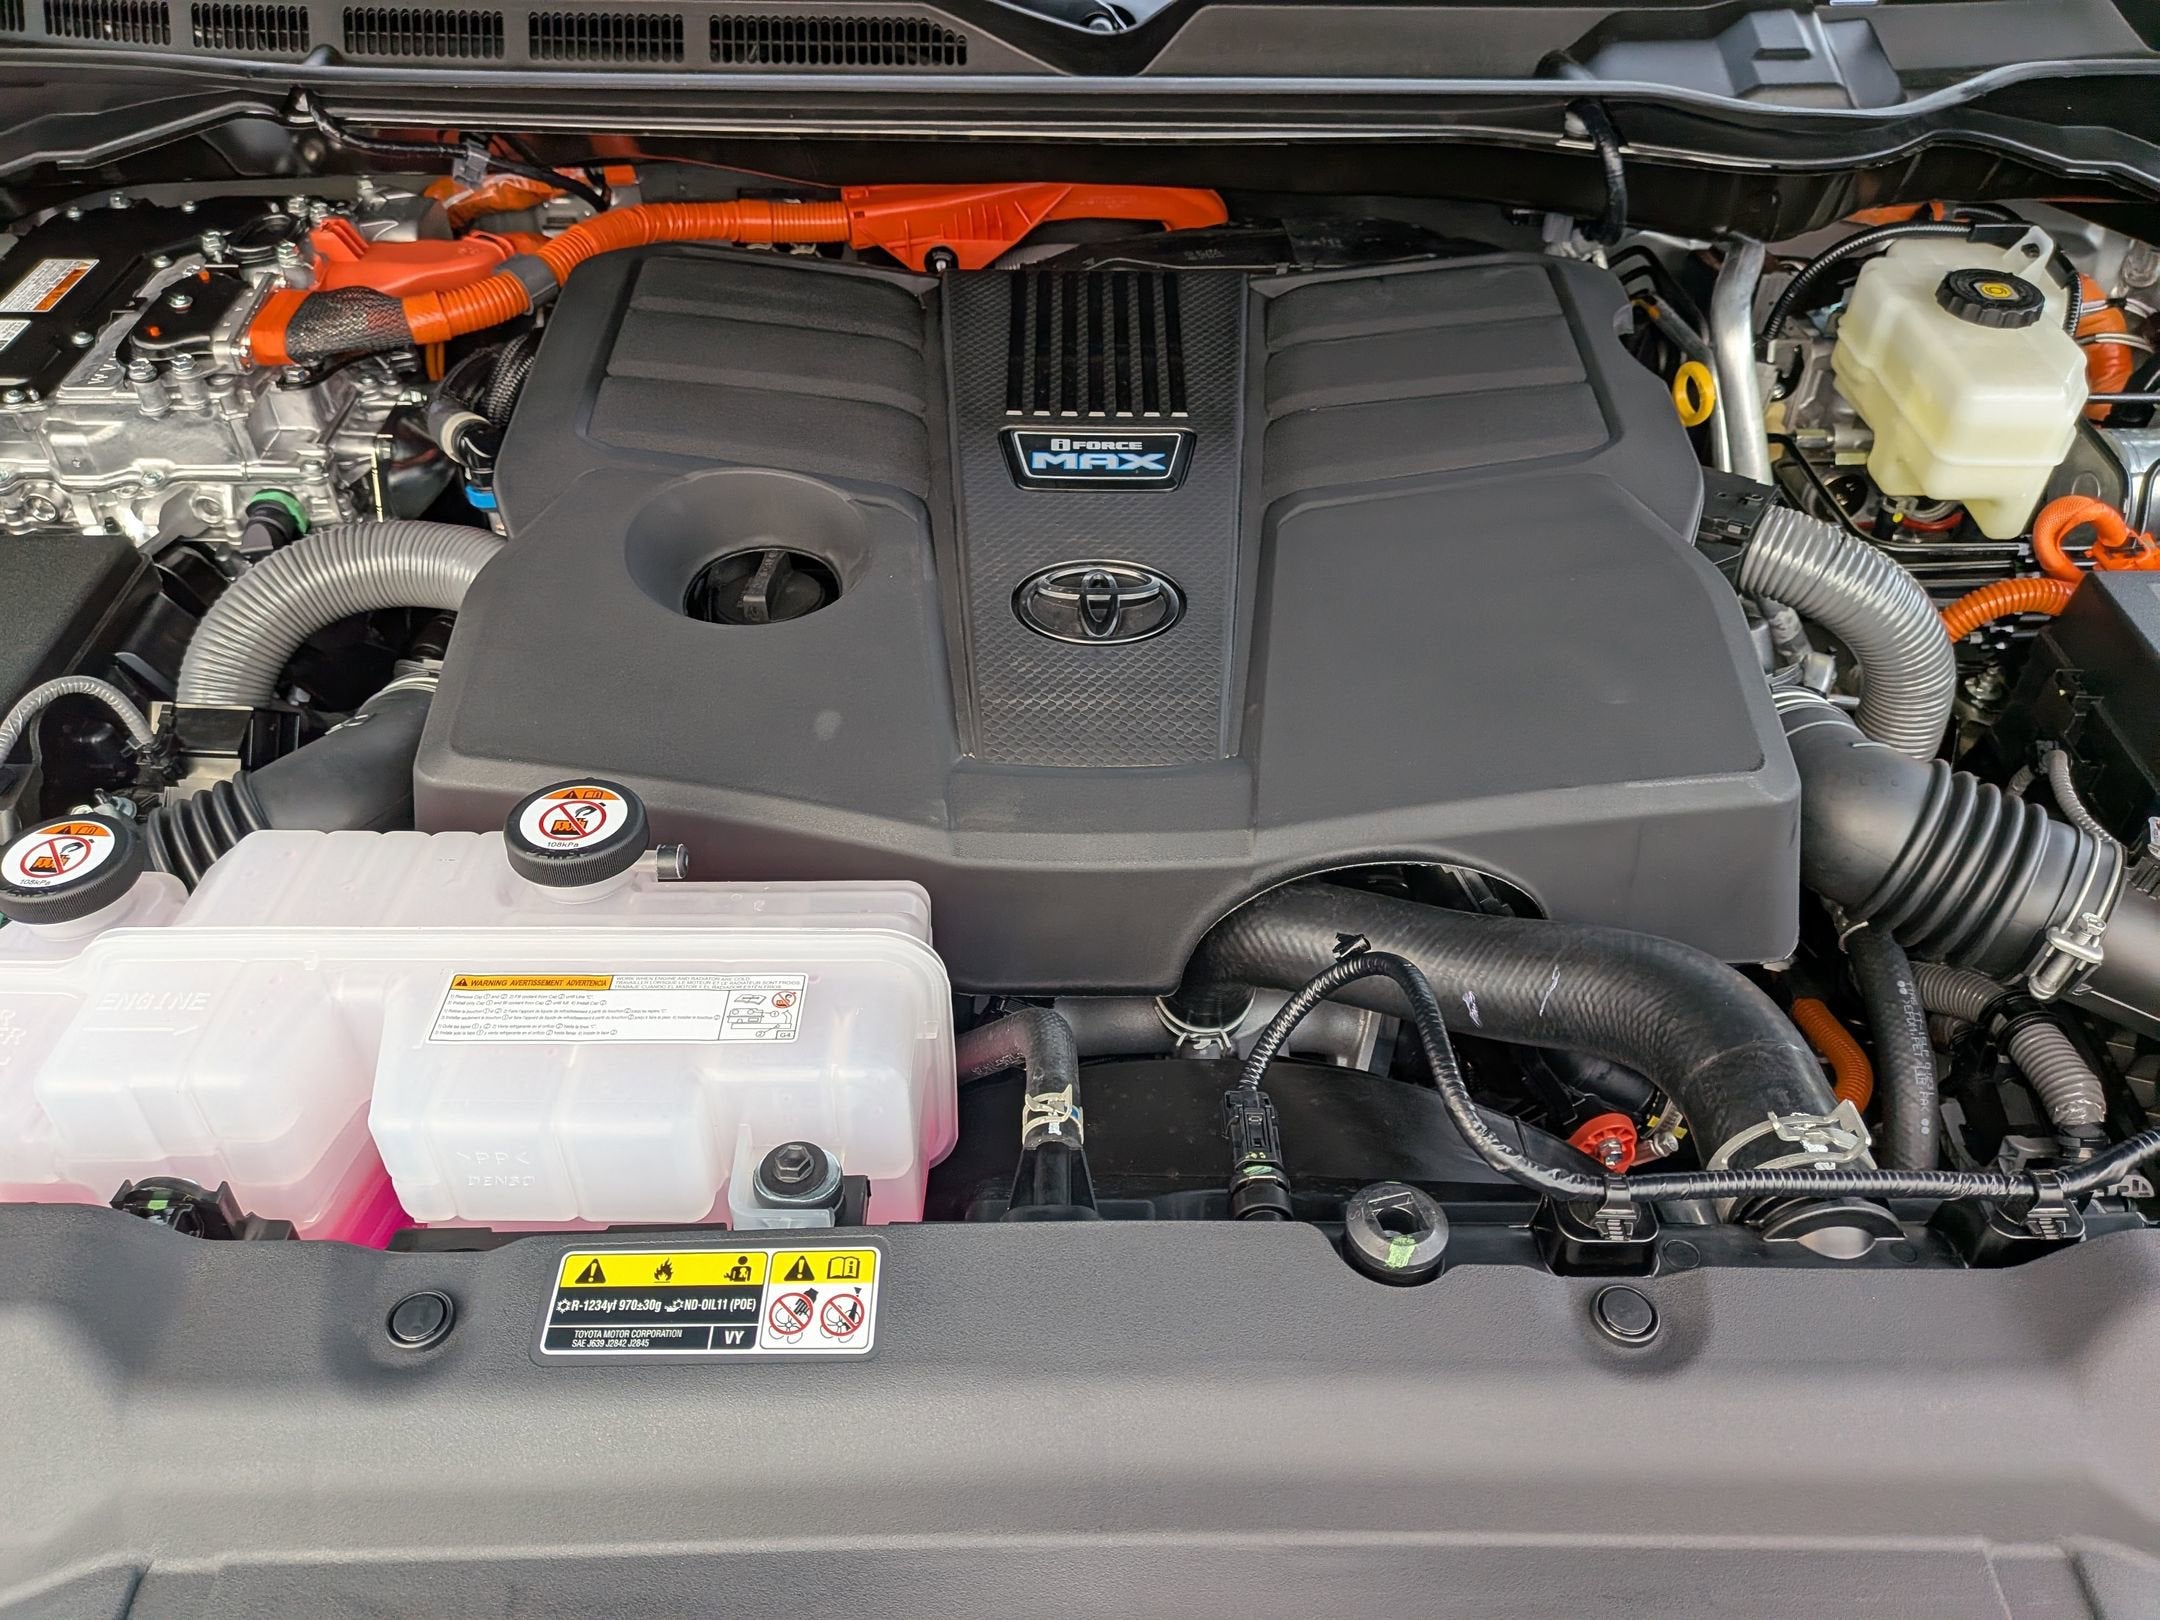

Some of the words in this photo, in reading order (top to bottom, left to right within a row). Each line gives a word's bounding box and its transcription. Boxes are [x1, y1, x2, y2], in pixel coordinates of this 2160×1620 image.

[1032, 452, 1166, 470] MAX
[470, 979, 507, 987] WARNING
[510, 979, 564, 987] AVERTISSEMENT
[566, 979, 607, 987] ADVERTENCIA
[96, 991, 212, 1011] ENGINE
[467, 1174, 537, 1187] DENSO
[571, 1299, 618, 1313] R-1234yf
[618, 1298, 662, 1313] 970±30g
[729, 1298, 756, 1312] (POE)
[574, 1330, 601, 1338] TOYOTA
[602, 1330, 629, 1338] MOTOR
[629, 1329, 683, 1338] CORPORATION
[724, 1331, 745, 1345] VY
[571, 1339, 587, 1347] SAE
[587, 1338, 605, 1347] J639
[605, 1338, 627, 1347] J2842
[627, 1338, 650, 1347] J2845
